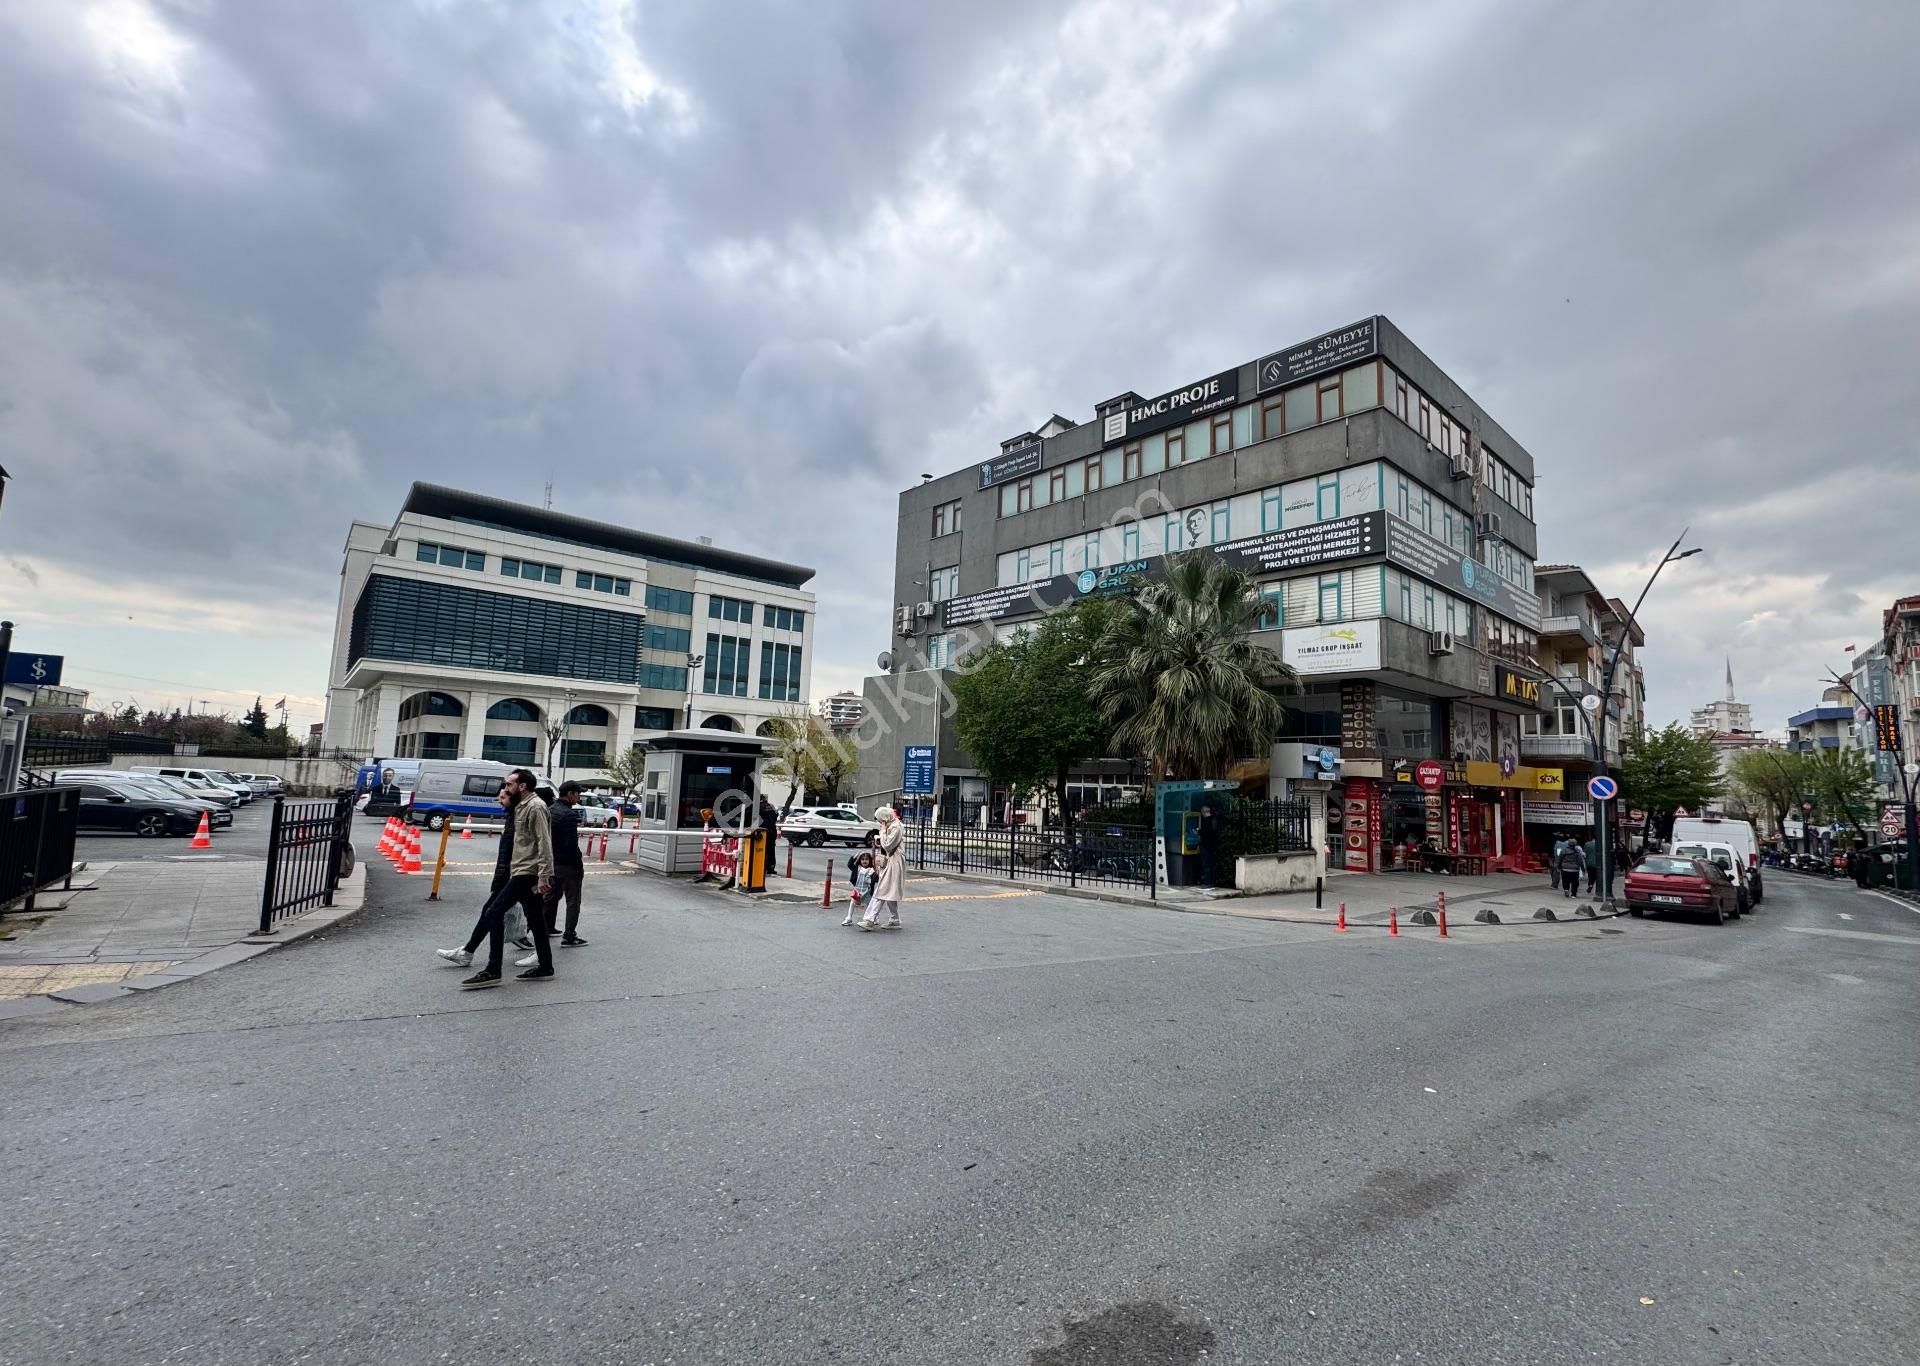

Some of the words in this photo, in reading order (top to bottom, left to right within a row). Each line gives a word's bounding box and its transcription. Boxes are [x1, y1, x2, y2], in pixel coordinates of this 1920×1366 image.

[1288, 349, 1312, 362] MİMAR
[1318, 324, 1372, 352] SÜMEYYE
[1132, 400, 1168, 423] HMC
[1170, 380, 1220, 410] PROJE
[1214, 536, 1264, 553] GAYRİMENKUL
[1265, 532, 1286, 543] SATIŞ
[1298, 518, 1359, 536] DANIŞMANLIĞI
[1240, 547, 1261, 556] YIKIM
[1262, 534, 1323, 553] MÜTEAHHİTLİĞİ
[1324, 527, 1359, 540] HİZMETİ
[1259, 552, 1282, 562] PROJE
[1284, 544, 1322, 557] YÖNETİMİ
[1323, 537, 1359, 550] MERKEZİ
[1265, 559, 1288, 569] PROJE
[1301, 552, 1322, 563] ETÜT
[1323, 547, 1359, 559] MERKEZİ
[1100, 560, 1148, 578] TUFAN
[1298, 646, 1319, 654] YILMAZ
[1321, 644, 1338, 652] GRUP
